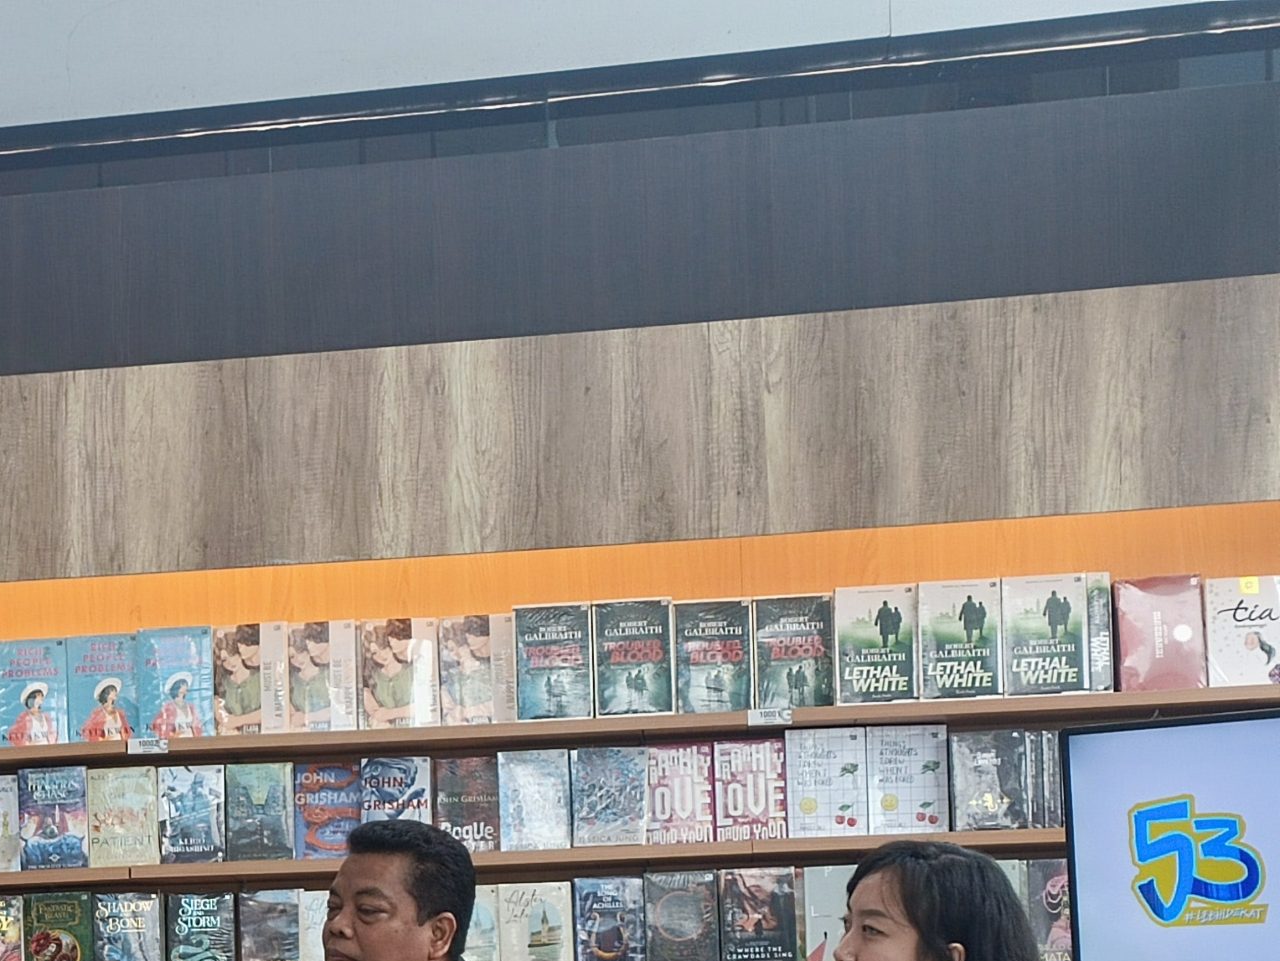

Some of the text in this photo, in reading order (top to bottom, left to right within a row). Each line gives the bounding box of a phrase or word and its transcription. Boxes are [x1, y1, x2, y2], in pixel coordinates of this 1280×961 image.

[605, 626, 662, 637] GALBRAITH
[685, 627, 742, 637] GALBRAITH
[765, 622, 823, 632] GALBRAITH
[771, 646, 824, 660] BLOOD
[861, 647, 889, 655] ROBERT
[930, 648, 990, 658] GALBRAITH
[1014, 644, 1075, 655] GALBRAITH
[611, 650, 663, 664] BLOOD
[690, 650, 743, 664] BLOOD
[847, 652, 905, 663] GALBRAITH
[1012, 656, 1070, 672] LETHAL
[2, 667, 60, 679] PROBLEMS
[75, 662, 134, 674] PROBLEMS
[844, 666, 900, 680] LETHAL
[928, 661, 984, 675] LETHAL
[936, 672, 992, 687] WHITE
[1021, 668, 1078, 684] WHITE
[852, 677, 908, 692] WHITE
[295, 772, 335, 785] JOHN
[362, 777, 404, 789] JOHN
[295, 792, 362, 805] GRISHAM
[648, 777, 712, 831] LOVE
[717, 773, 786, 830] LOVE
[362, 800, 429, 812] GRISHAM
[91, 835, 154, 848] PATIENT
[96, 901, 154, 920] SHADOW
[179, 898, 218, 918] SIEGE
[107, 915, 146, 934] BONE
[175, 915, 221, 936] STORM
